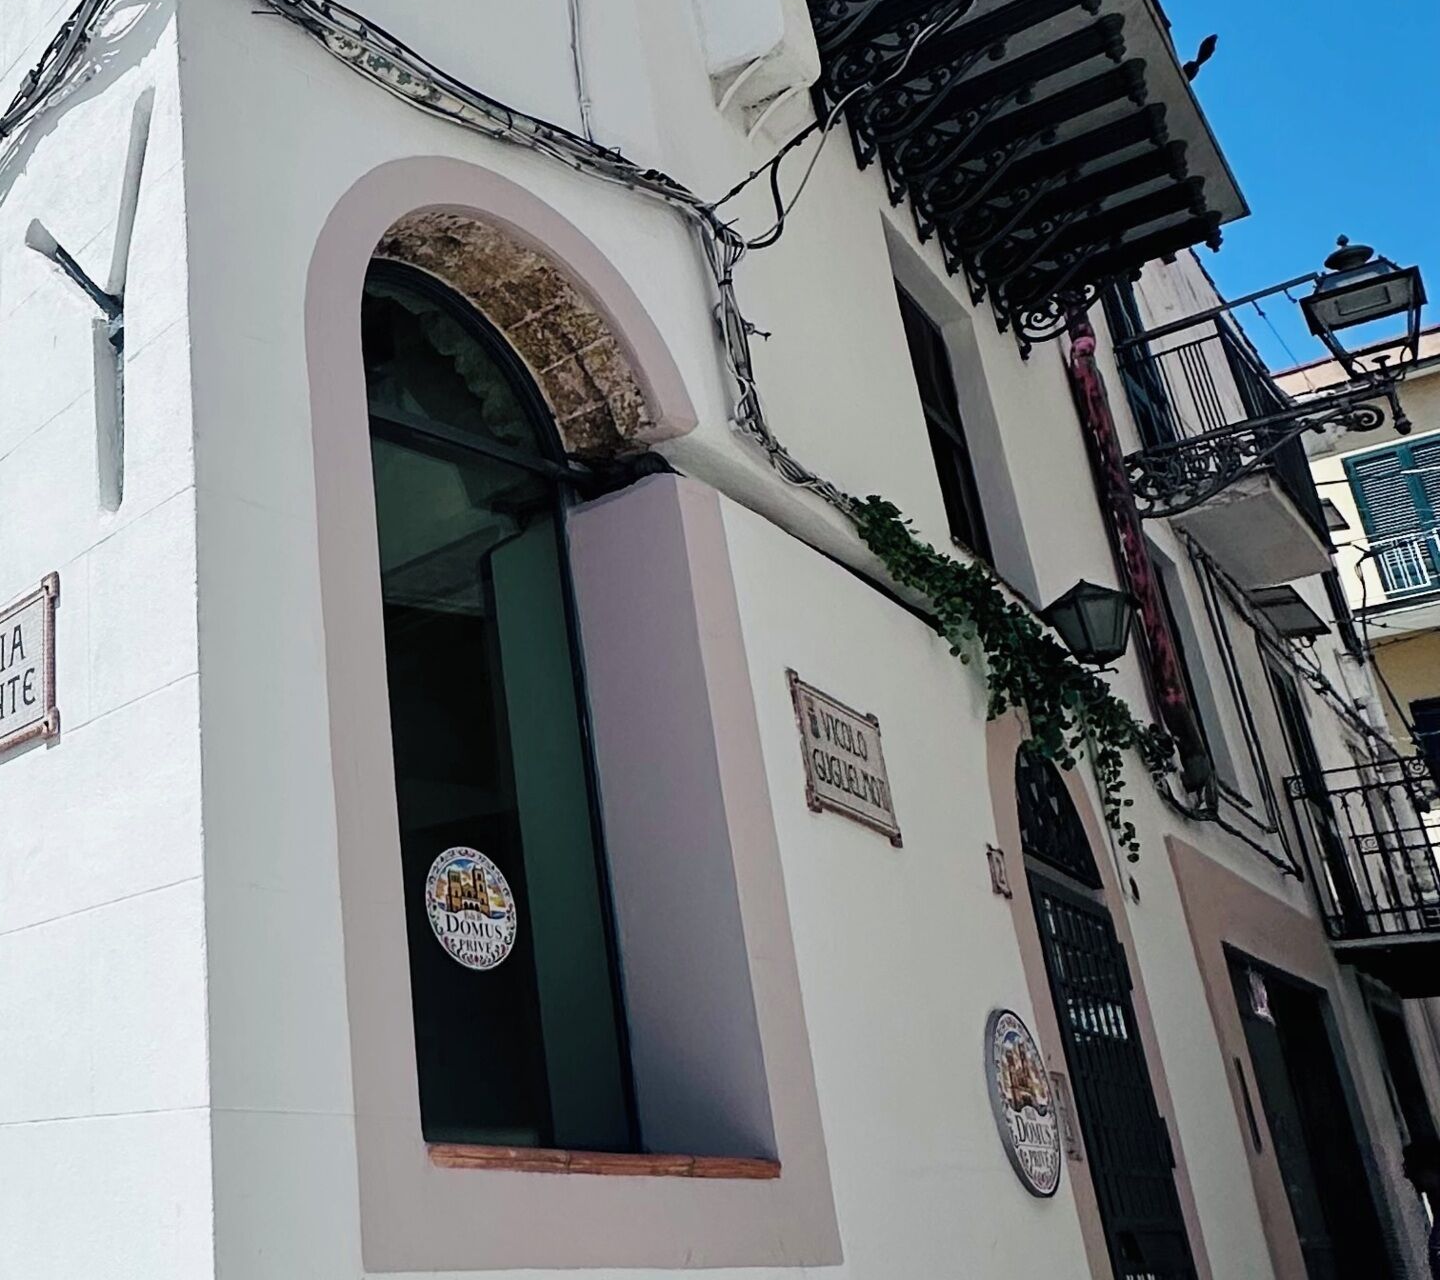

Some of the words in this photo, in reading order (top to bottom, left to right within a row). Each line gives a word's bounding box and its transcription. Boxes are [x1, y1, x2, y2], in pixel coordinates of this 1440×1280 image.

[820, 709, 868, 762] VICOLO
[813, 749, 882, 808] GUGLIELMO
[446, 914, 503, 939] DOMUS
[1015, 1114, 1052, 1145] DOMUS
